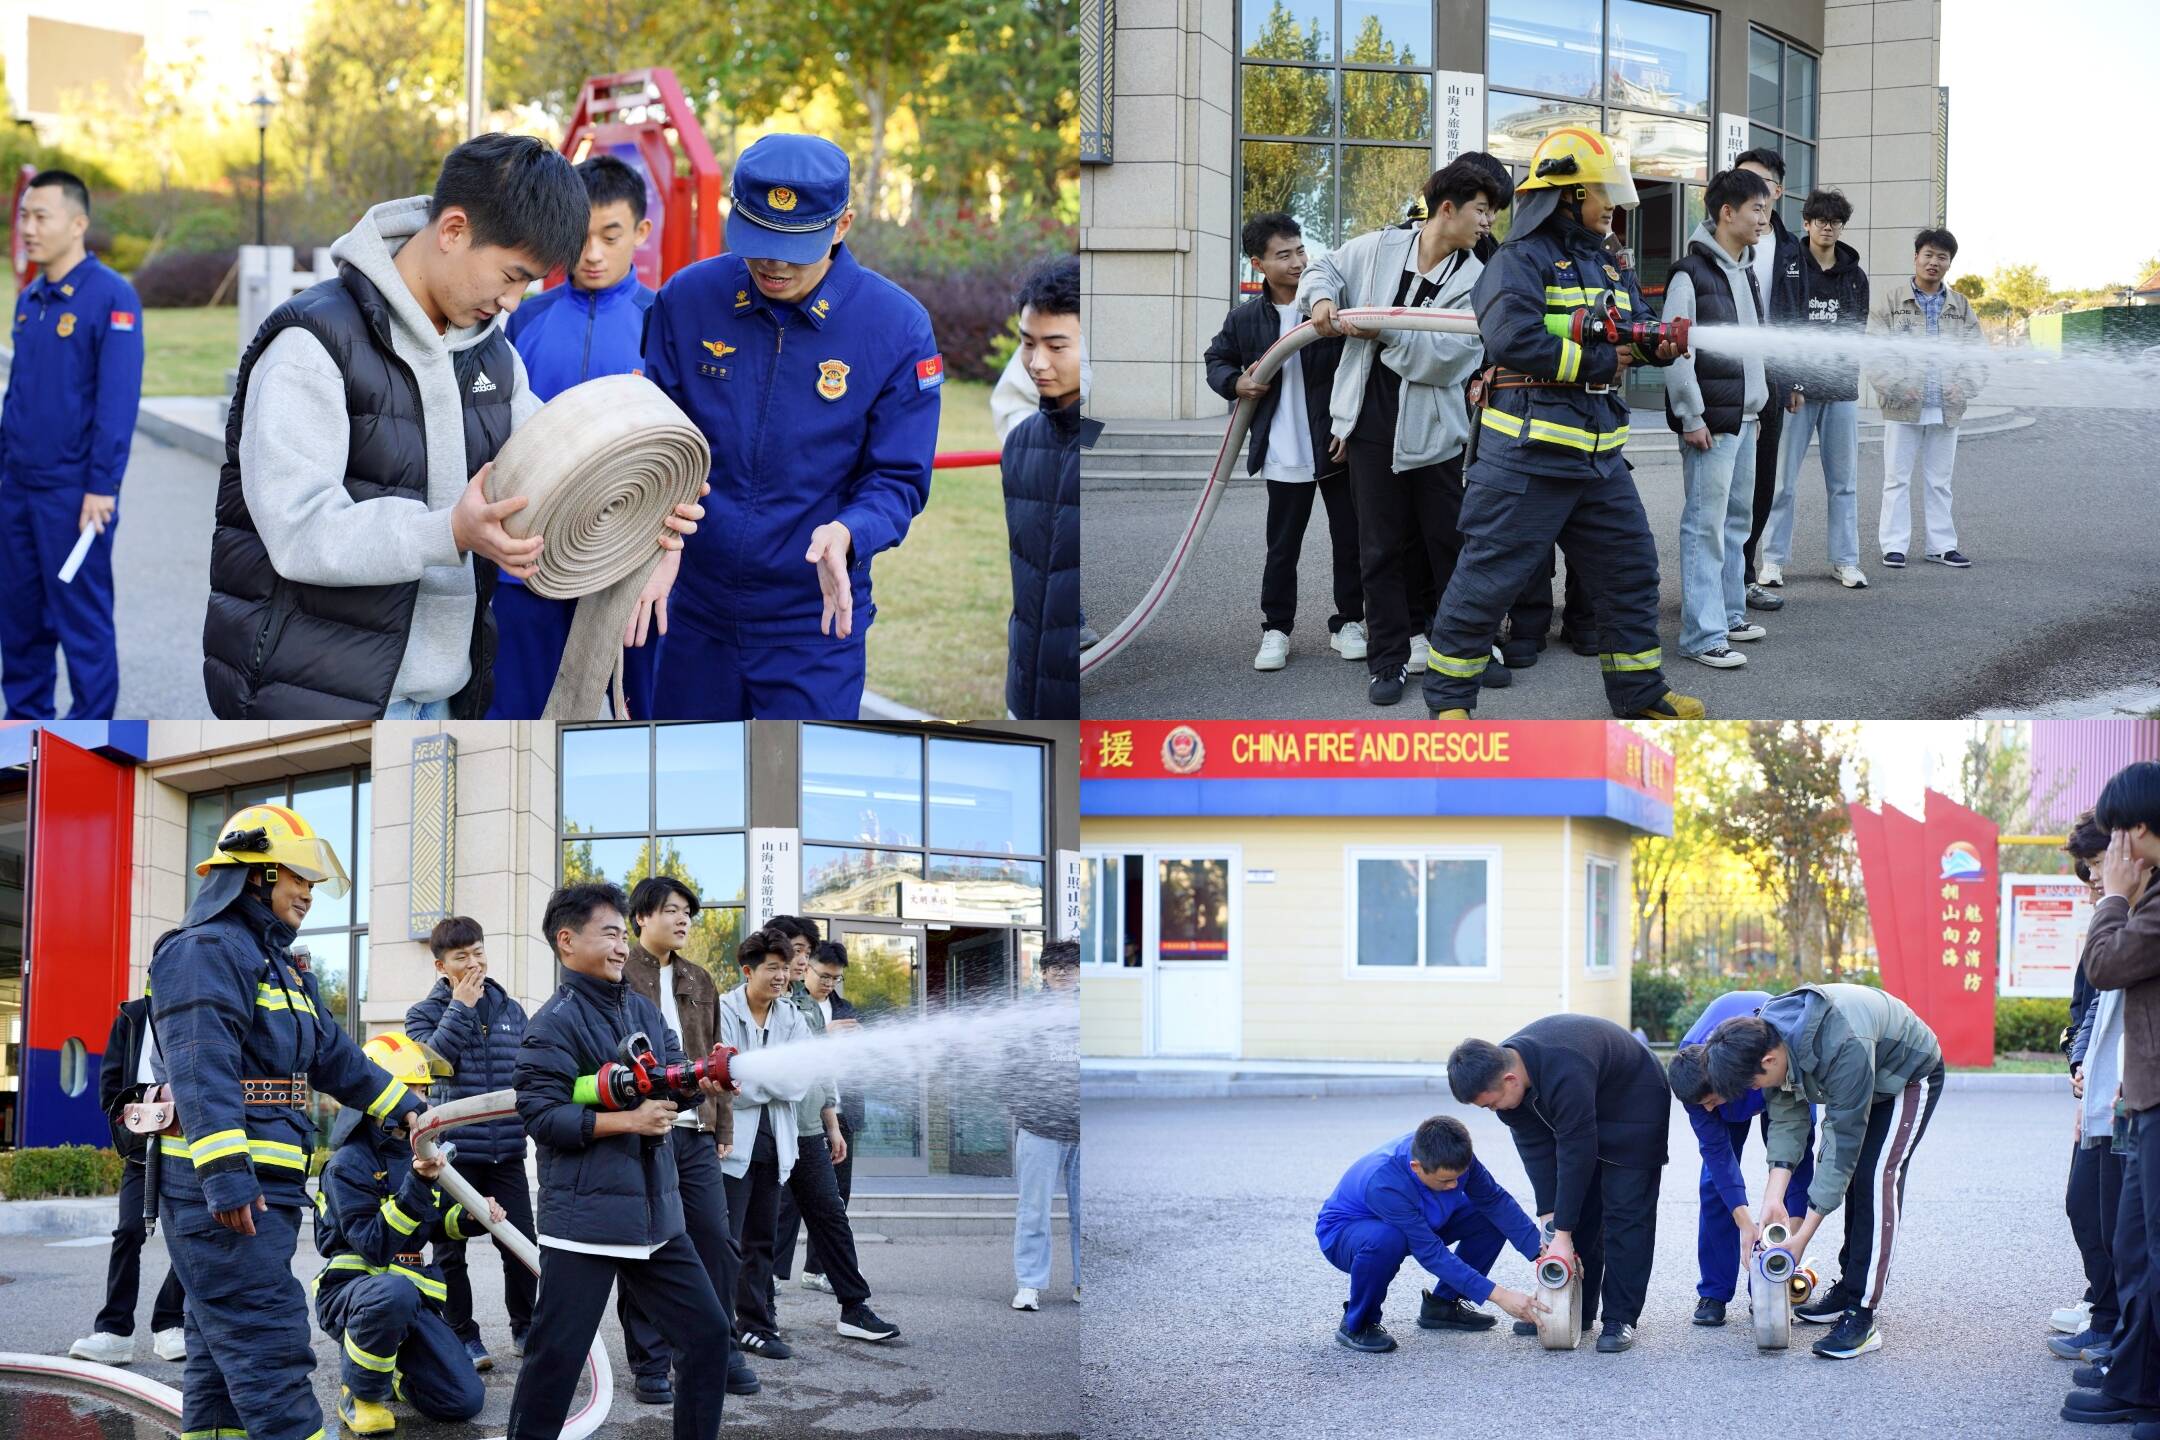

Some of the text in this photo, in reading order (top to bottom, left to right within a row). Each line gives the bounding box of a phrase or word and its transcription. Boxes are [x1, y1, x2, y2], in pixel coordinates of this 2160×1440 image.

[1447, 85, 1460, 166] 山海天旅游度假
[1727, 124, 1744, 170] 日照山
[472, 383, 496, 393] adidas
[1080, 731, 1134, 767] 援
[1232, 732, 1510, 764] CHINA FIRE AND RESCUE
[761, 841, 774, 927] 山海天旅游度假
[1067, 862, 1080, 938] 日照山海天
[1964, 904, 1983, 992] 魅力消防
